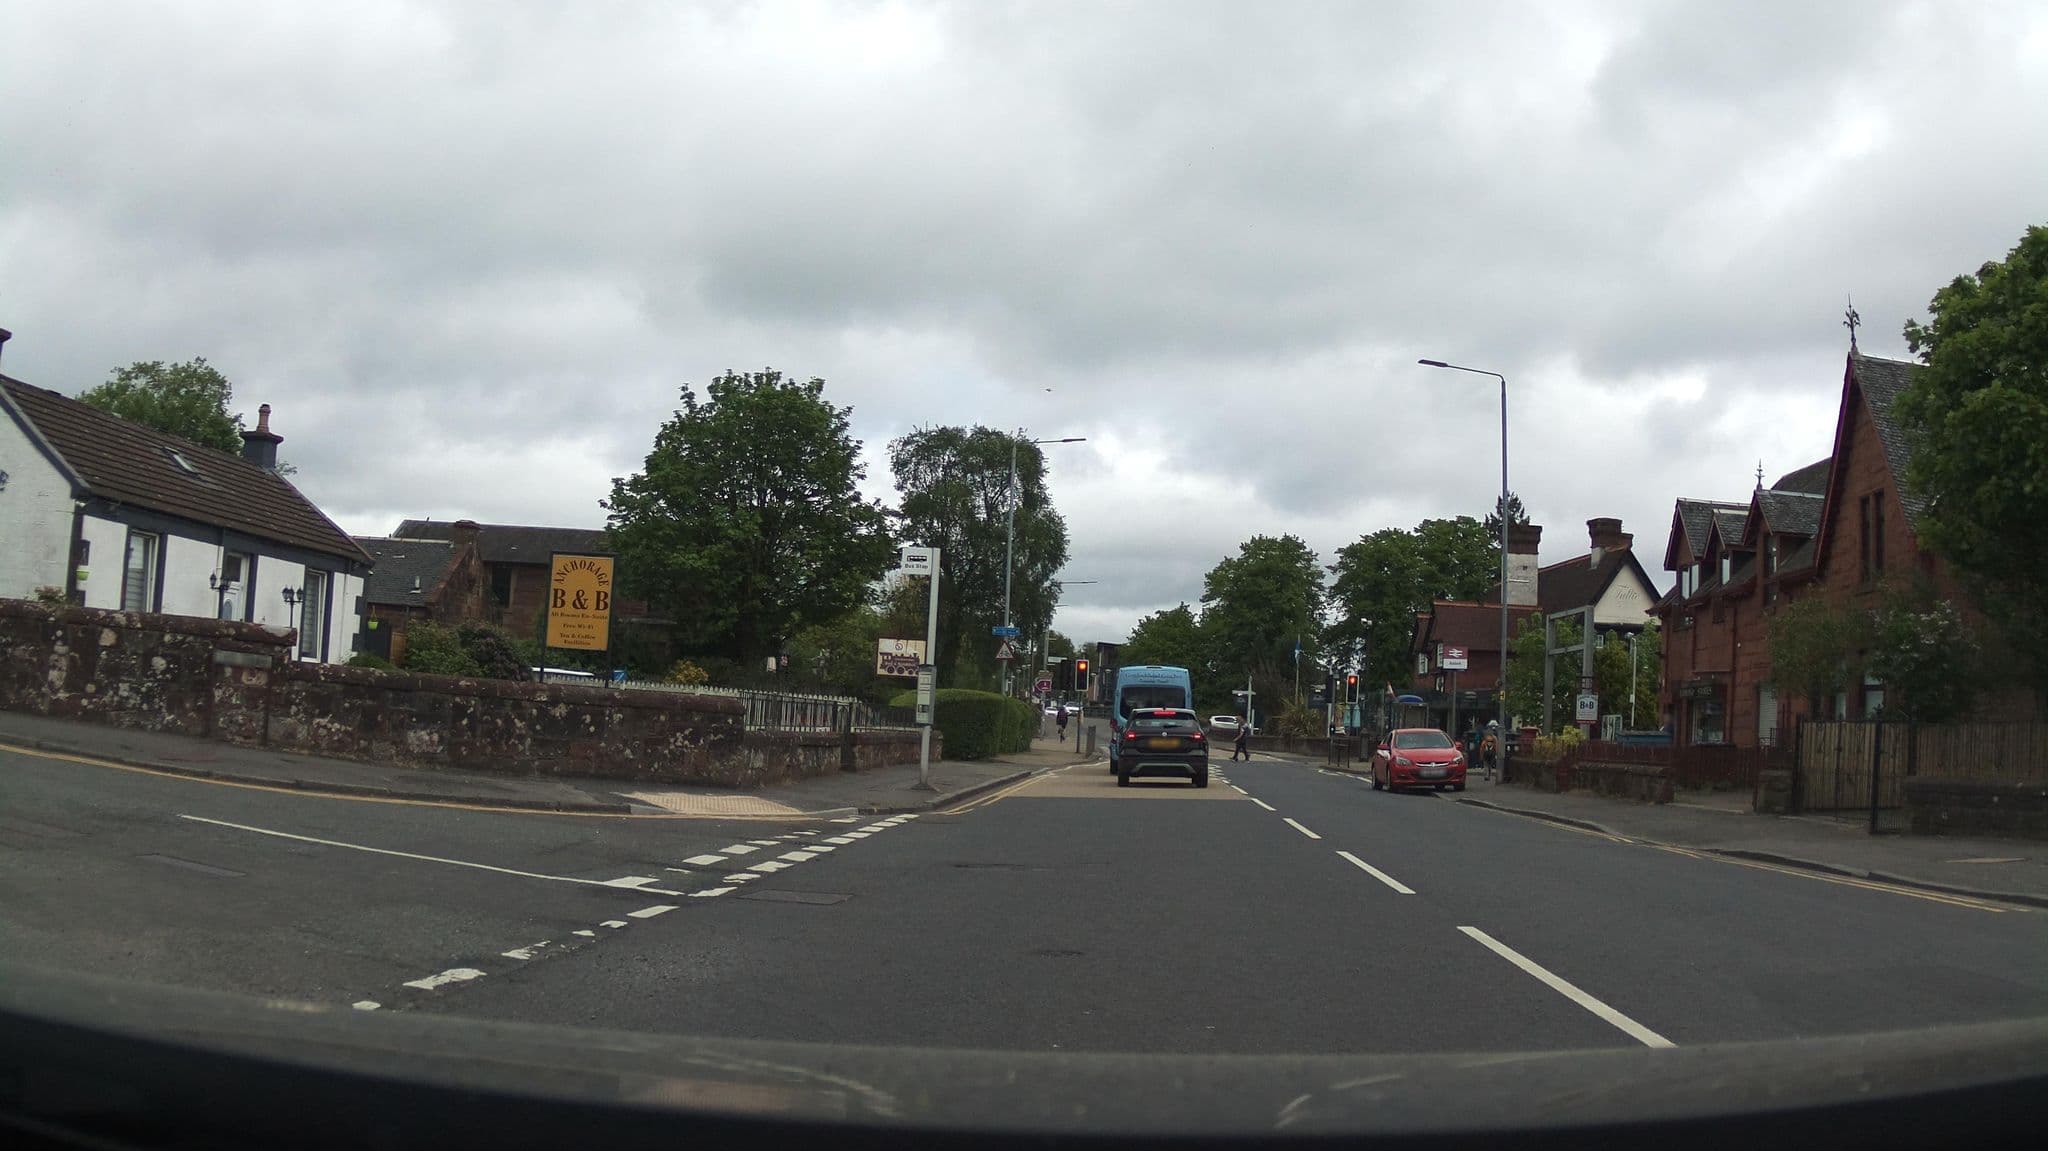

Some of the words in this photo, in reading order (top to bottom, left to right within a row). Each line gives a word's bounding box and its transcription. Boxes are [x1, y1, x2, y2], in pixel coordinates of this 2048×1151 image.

[554, 560, 609, 586] ANCHORAGE
[552, 588, 567, 609] B
[572, 589, 589, 610] &
[595, 590, 609, 612] B
